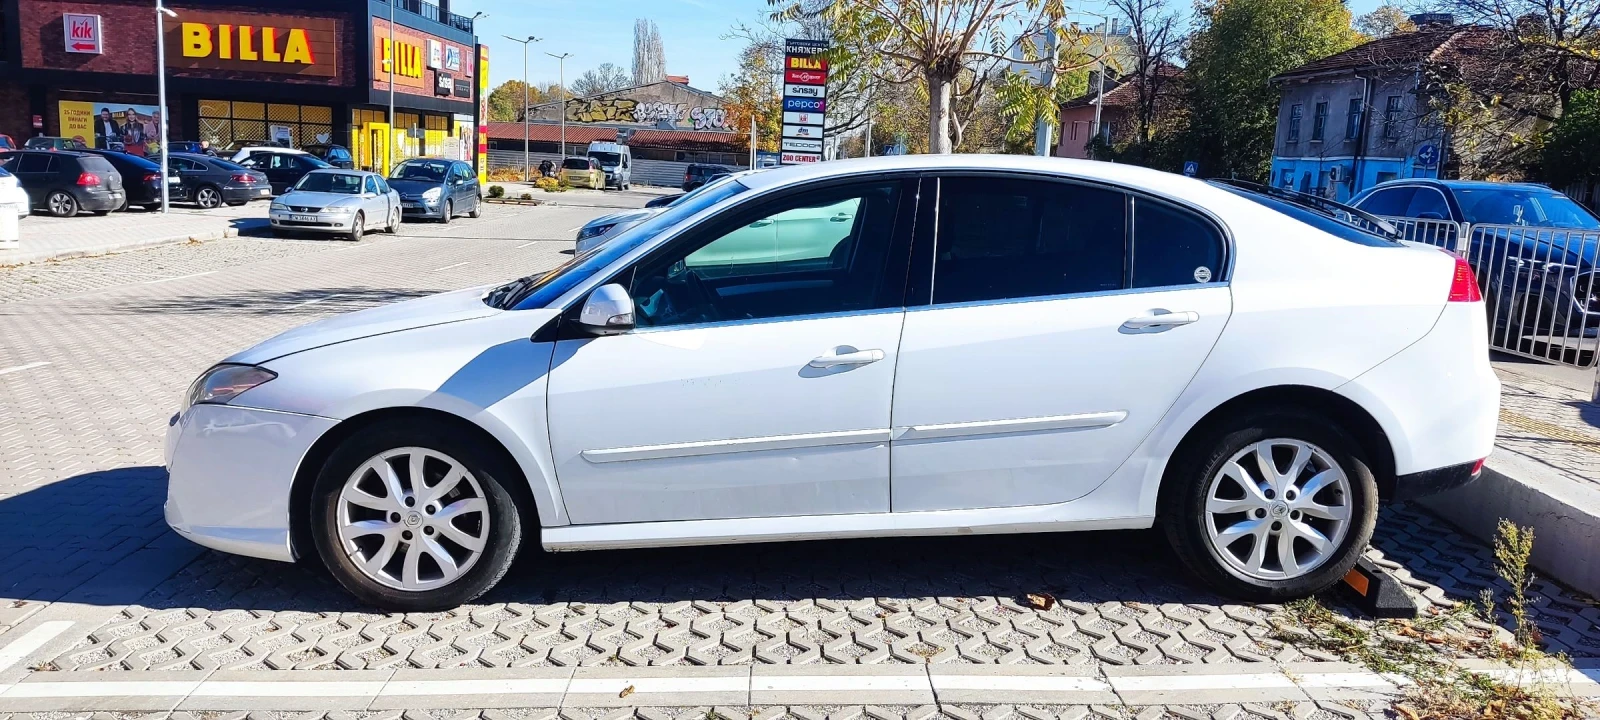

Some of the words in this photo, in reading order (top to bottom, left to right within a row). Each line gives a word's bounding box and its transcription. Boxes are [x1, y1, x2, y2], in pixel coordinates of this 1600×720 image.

[72, 20, 93, 39] kik
[182, 22, 315, 64] BILLA
[382, 37, 422, 79] BILLA
[790, 58, 821, 69] BILLA
[792, 86, 818, 96] sinsay
[788, 100, 820, 109] pepco
